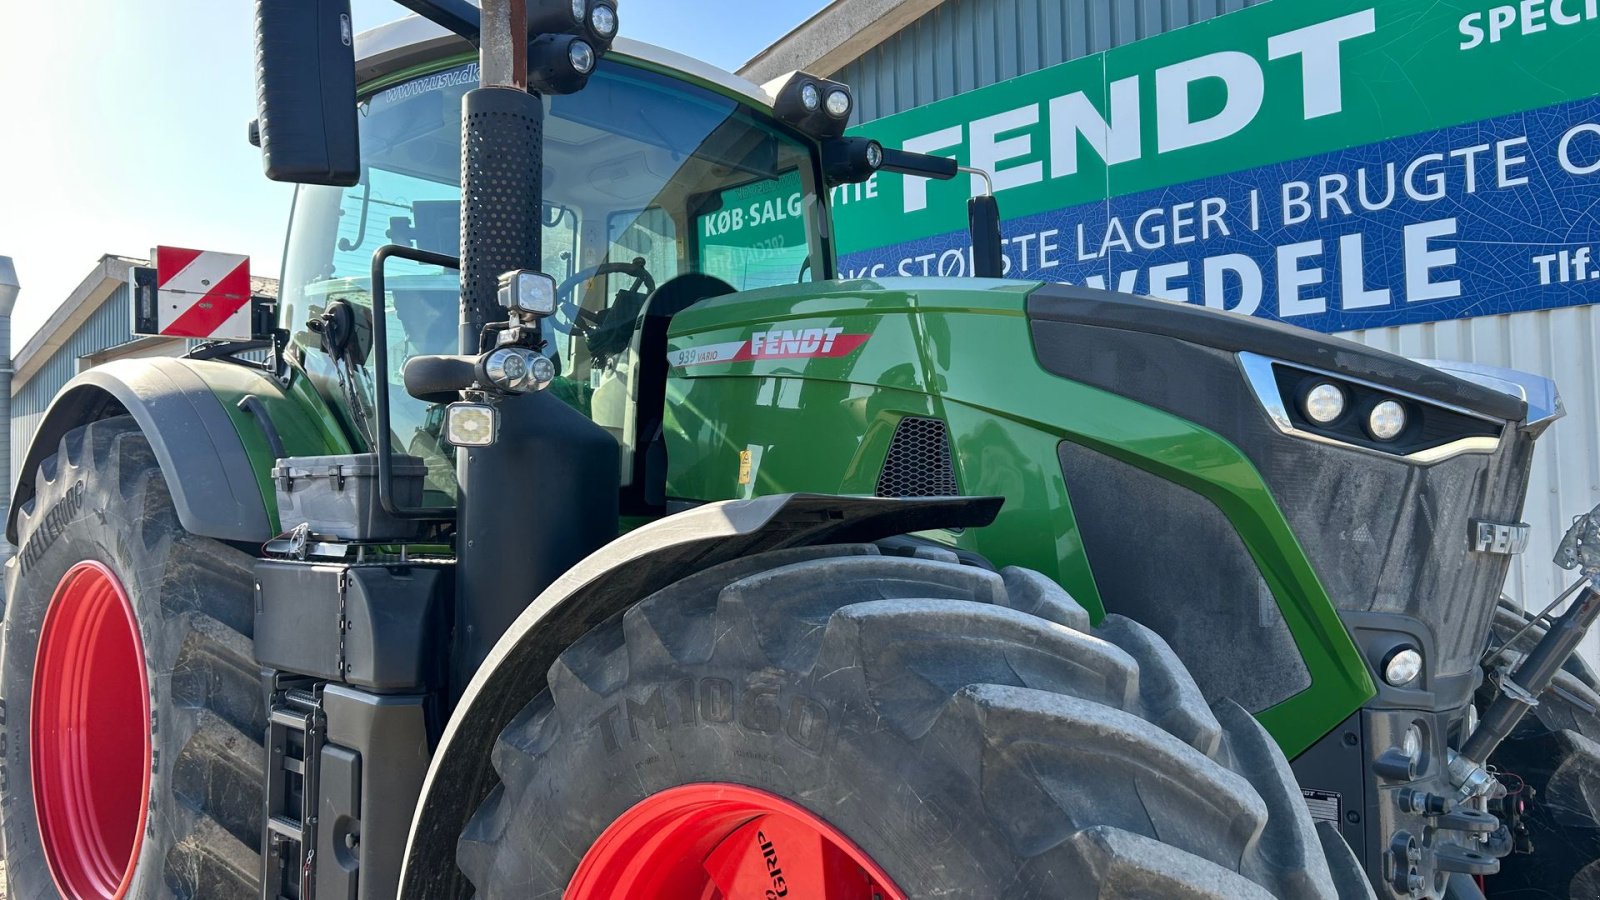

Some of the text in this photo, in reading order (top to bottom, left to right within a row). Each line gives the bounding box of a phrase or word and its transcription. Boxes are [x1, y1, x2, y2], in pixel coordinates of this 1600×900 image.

[386, 63, 480, 103] www.usv.dk
[902, 8, 1375, 213] FENDT
[1077, 197, 1231, 261] LAGER
[1251, 189, 1260, 231] I
[1283, 136, 1529, 226] BRUGTE
[1532, 246, 1600, 286] Tlf.
[678, 326, 845, 365] 939 VARIO FENDT
[757, 830, 789, 898] GRIP
